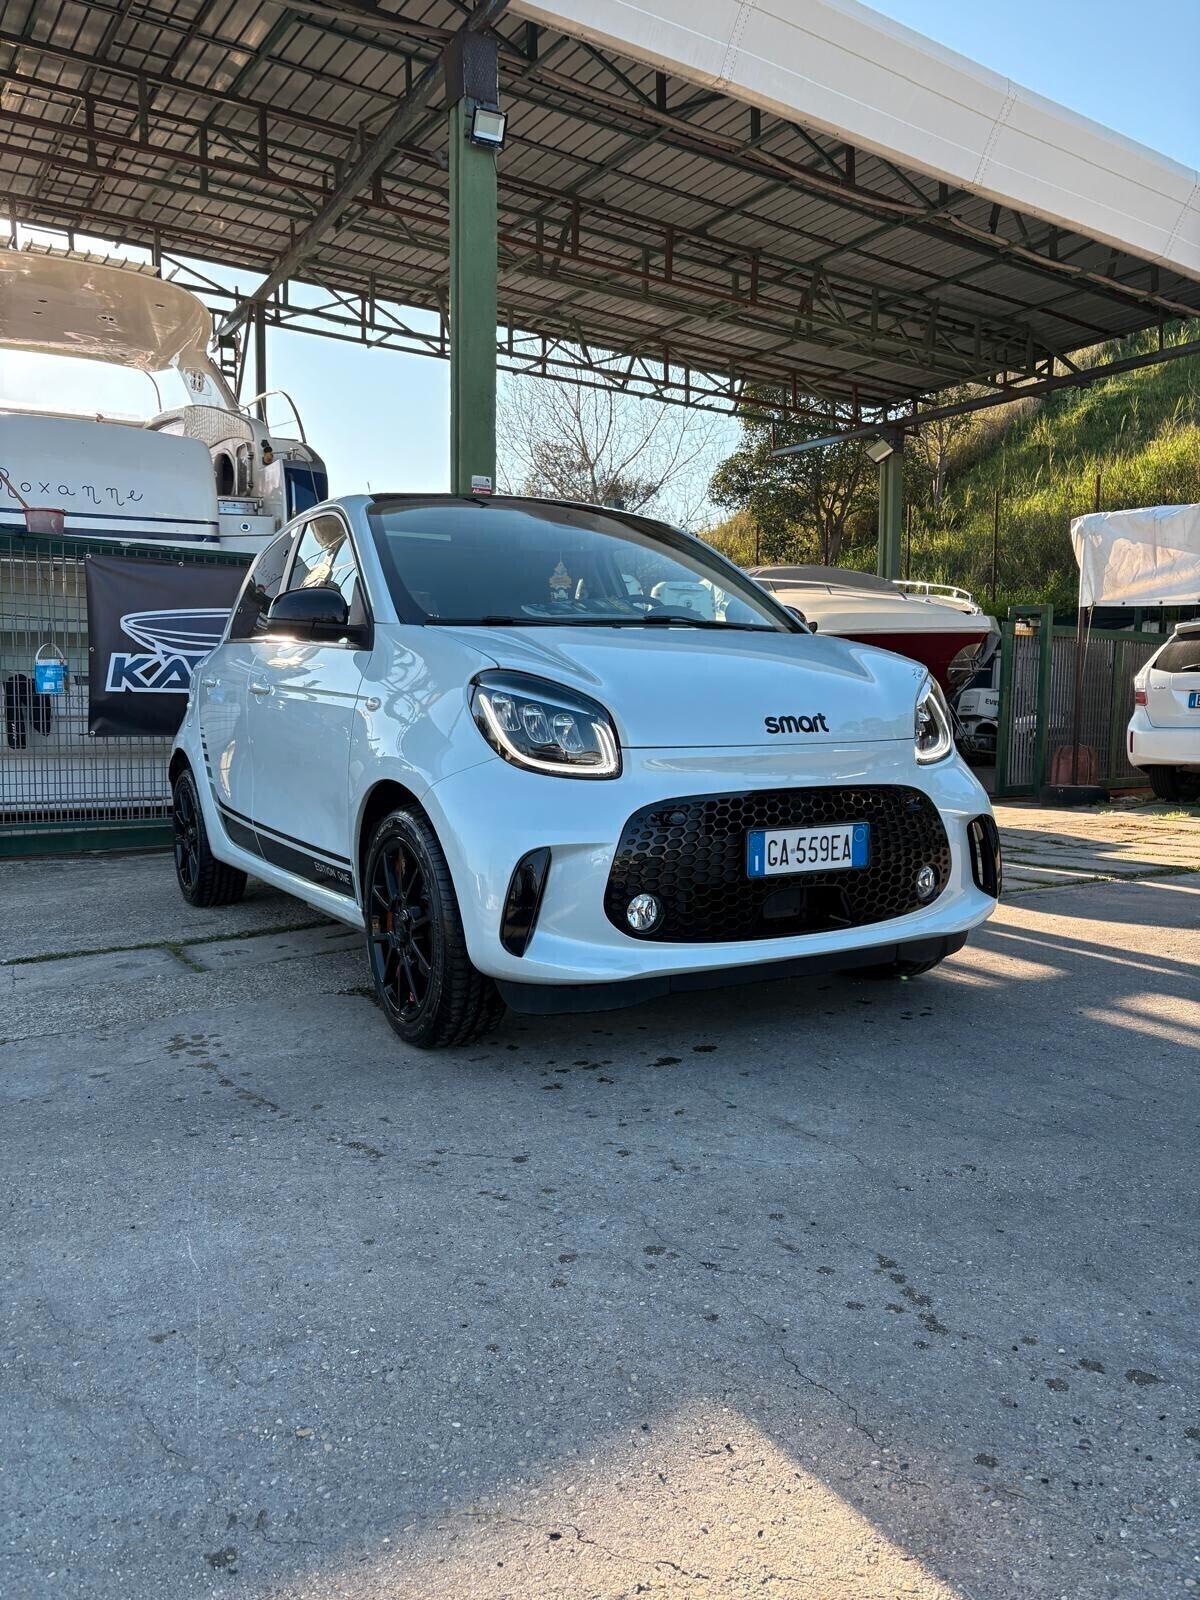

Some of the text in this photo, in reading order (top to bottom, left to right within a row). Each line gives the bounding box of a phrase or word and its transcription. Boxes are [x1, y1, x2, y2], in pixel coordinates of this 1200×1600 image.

[105, 652, 191, 693] KA
[764, 712, 830, 734] smart
[767, 834, 852, 867] GA 559EA
[313, 861, 351, 885] EDITION ONE
